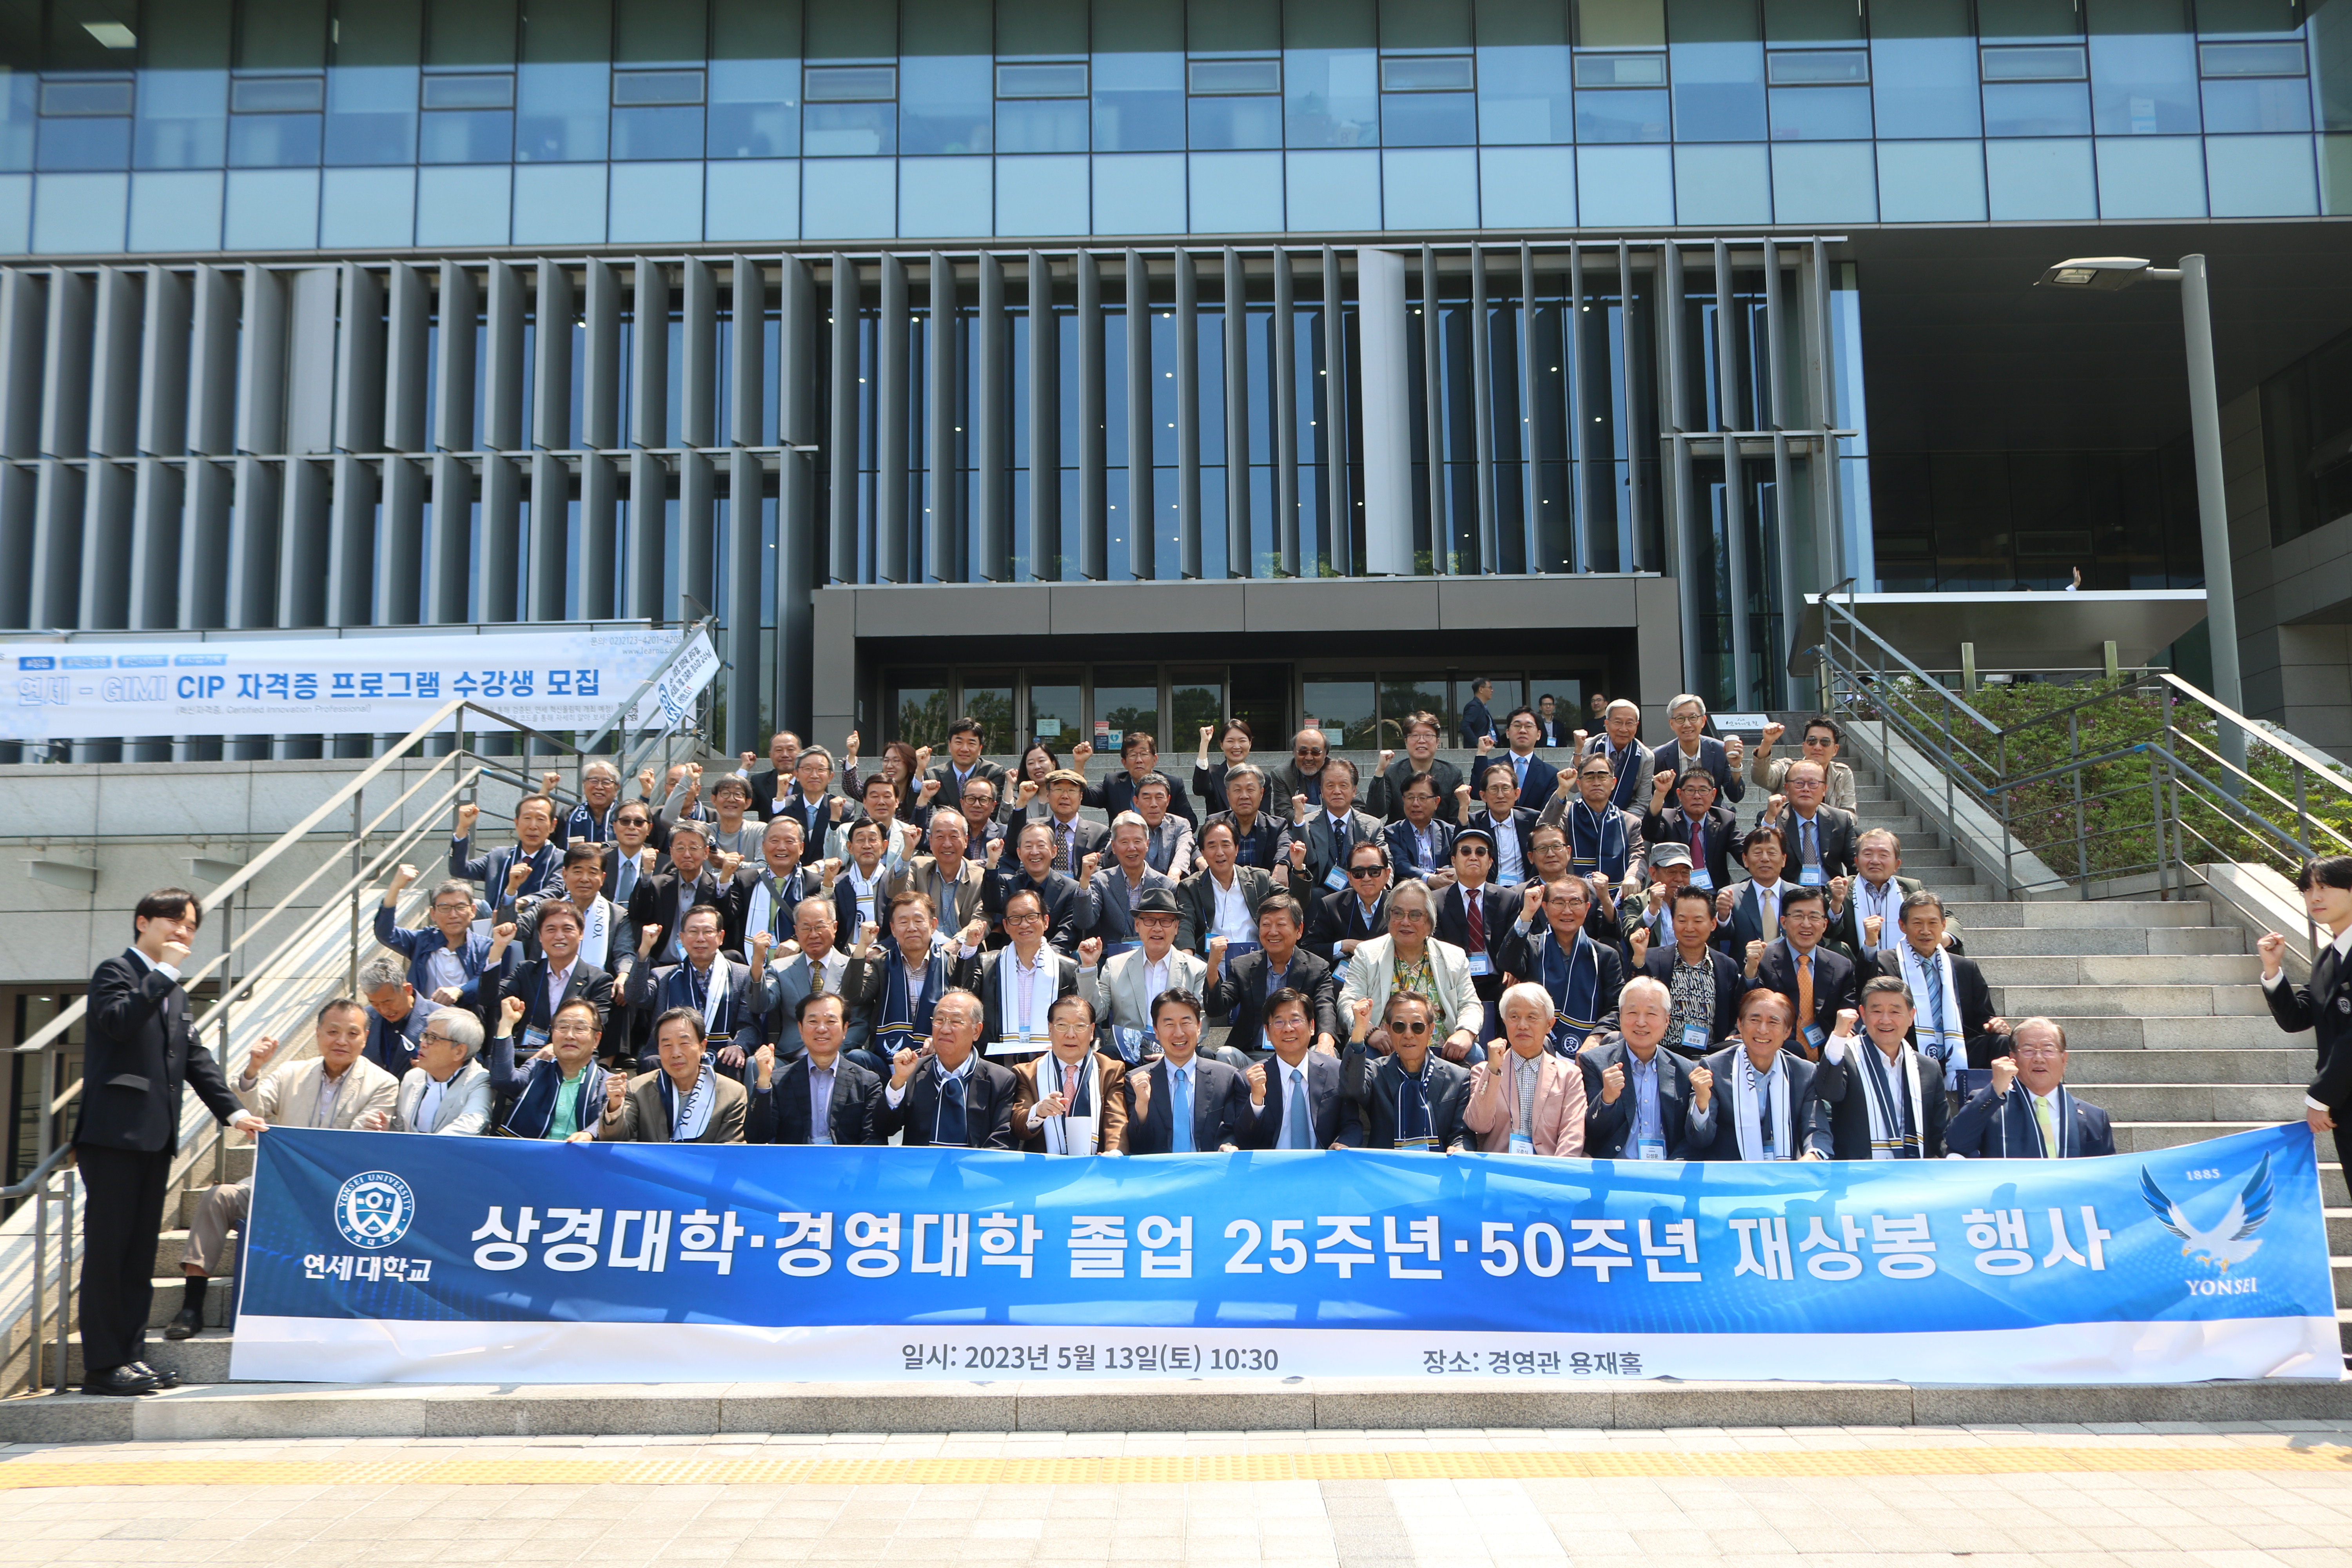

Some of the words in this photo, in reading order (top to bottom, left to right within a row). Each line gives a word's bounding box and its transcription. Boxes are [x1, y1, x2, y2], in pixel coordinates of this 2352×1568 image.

[18, 677, 70, 706] 연세
[102, 675, 167, 702] GIMI
[177, 675, 225, 699] CIP
[237, 673, 318, 700] 자격증
[330, 671, 439, 698] 프로그램
[454, 670, 534, 698] 수강생
[547, 669, 599, 696] 모집
[227, 706, 265, 714] Certified
[267, 705, 312, 714] Innovation
[592, 899, 604, 939] YONSEI
[679, 1078, 705, 1127] YONSEI
[2186, 1169, 2220, 1181] 1885
[339, 1177, 364, 1207] YONSEI
[368, 1174, 412, 1211] UNIVERSITY
[1067, 1214, 1193, 1279] 졸업
[1730, 1214, 1936, 1281] 재상봉
[1962, 1205, 2111, 1275] 행사
[303, 1254, 432, 1282] 연세대학교
[2185, 1277, 2257, 1295] YONSEI
[902, 1344, 956, 1370] 일시:
[964, 1344, 1048, 1370] 2023년
[1057, 1345, 1095, 1371] 5월
[1105, 1343, 1201, 1372] 13일(토)
[1210, 1348, 1278, 1370] 10:30
[1423, 1349, 1479, 1374] 장소:
[1488, 1350, 1561, 1374] 경영관
[1569, 1351, 1643, 1375] 용재홀
